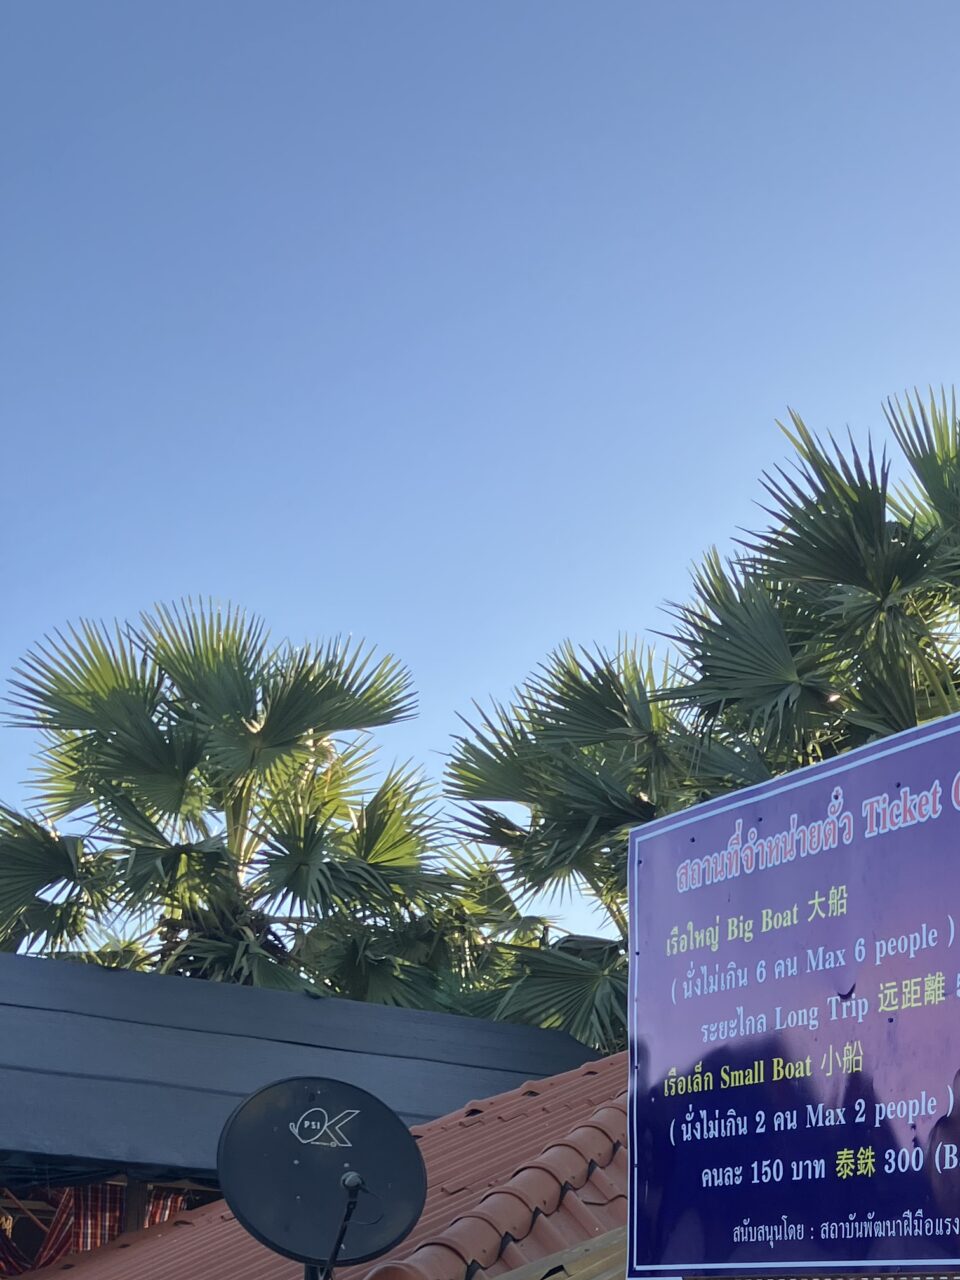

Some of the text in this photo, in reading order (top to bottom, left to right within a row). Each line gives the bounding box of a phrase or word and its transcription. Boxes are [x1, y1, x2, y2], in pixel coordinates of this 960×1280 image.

[676, 786, 853, 893] สถานที่จำหน่ายตั๋ว
[862, 780, 942, 838] Ticket
[666, 885, 848, 956] เรือใหญ่ Big Boat 大船
[683, 961, 748, 1000] นั่งไม่เกิน
[756, 961, 767, 983] 6
[775, 957, 797, 979] คน
[806, 946, 846, 973] Max
[854, 938, 866, 962] 6
[875, 923, 938, 965] people
[701, 1006, 767, 1043] ระยะไกล
[775, 1006, 819, 1031] Long
[827, 991, 869, 1024] Trip
[878, 971, 946, 1013] 远距離
[664, 1040, 863, 1097] เรือเล็ก Small Boat 小船
[304, 1120, 320, 1130] PSI
[681, 1104, 748, 1142] นั่งไม่เกิน
[755, 1111, 766, 1134] 2
[773, 1109, 797, 1132] คน
[806, 1103, 846, 1129] Max
[855, 1098, 866, 1123] 2
[874, 1091, 937, 1128] people
[701, 1165, 743, 1188] คนละ
[751, 1158, 783, 1184] 150
[791, 1157, 826, 1181] บาท
[835, 1146, 876, 1180] 泰銖
[884, 1147, 924, 1174] 300
[732, 1215, 804, 1248] สนับสนุนโดย
